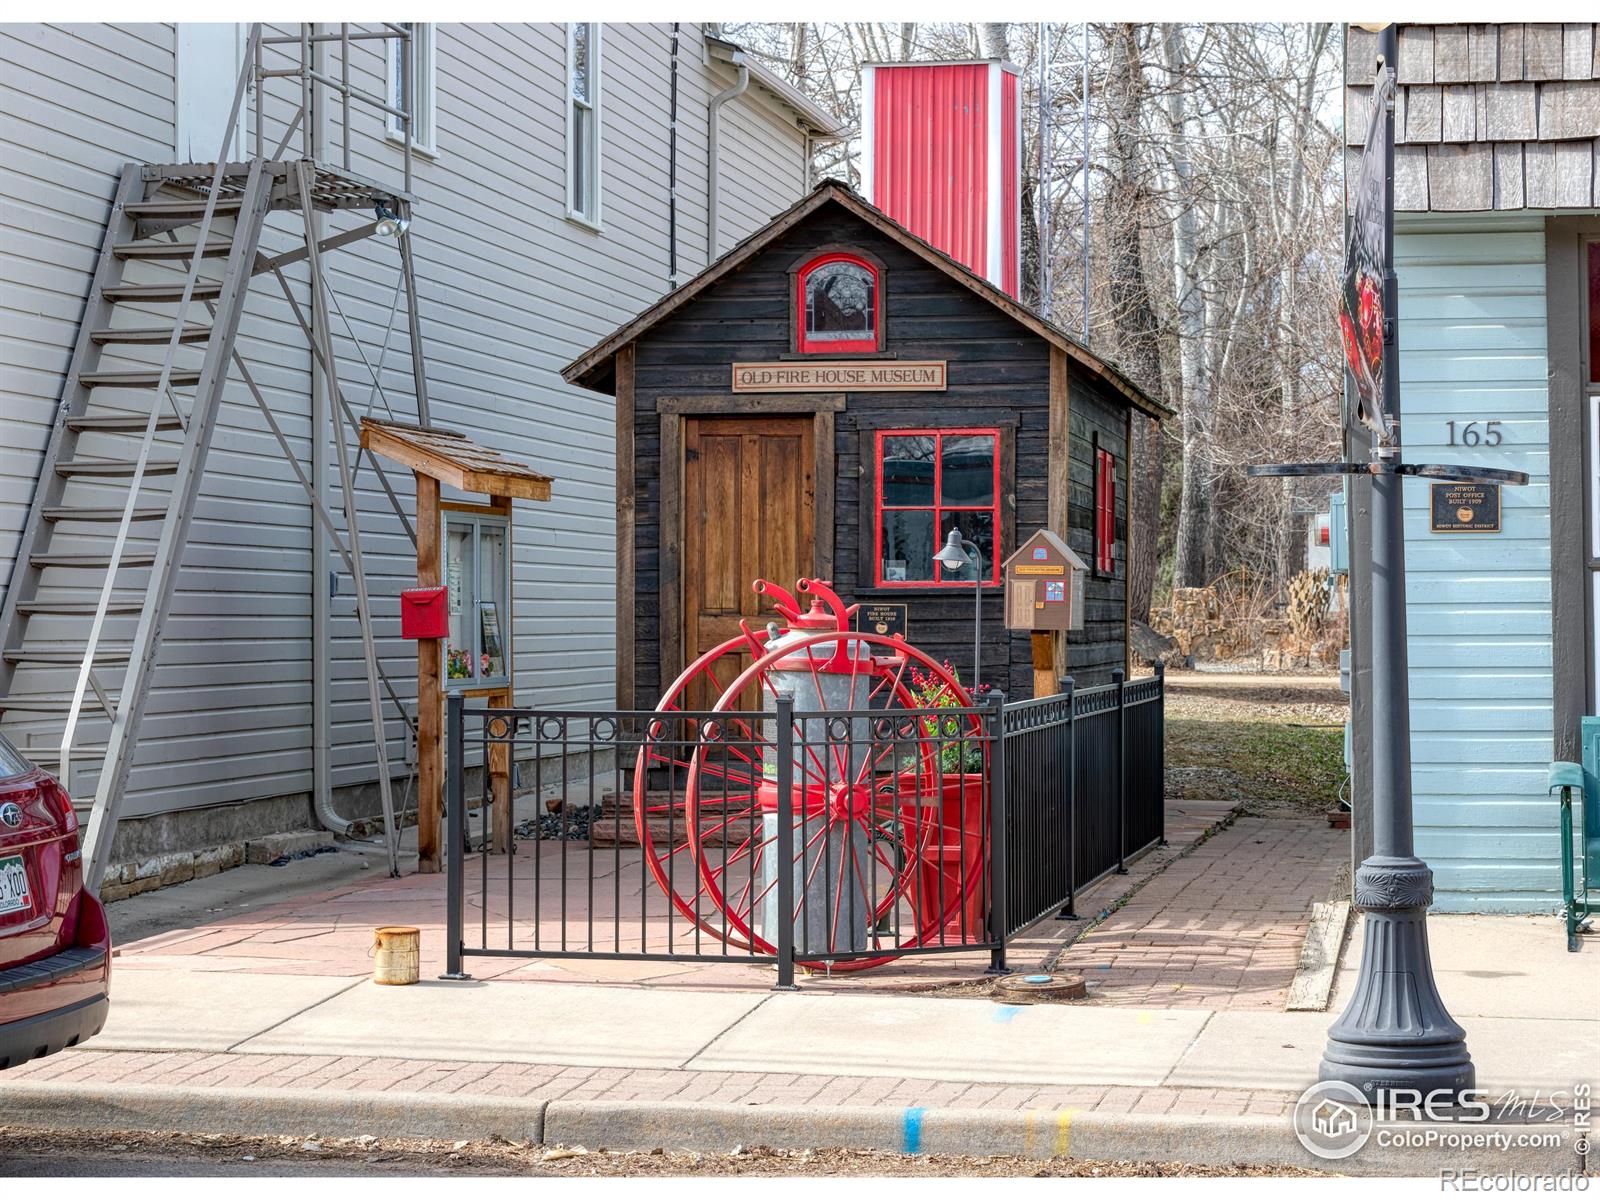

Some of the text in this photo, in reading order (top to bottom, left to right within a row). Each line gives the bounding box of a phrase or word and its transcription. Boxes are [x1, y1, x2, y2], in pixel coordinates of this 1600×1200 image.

[741, 369, 936, 385] OLD FIRE HOUSE MUSEUM
[1446, 420, 1502, 447] 165
